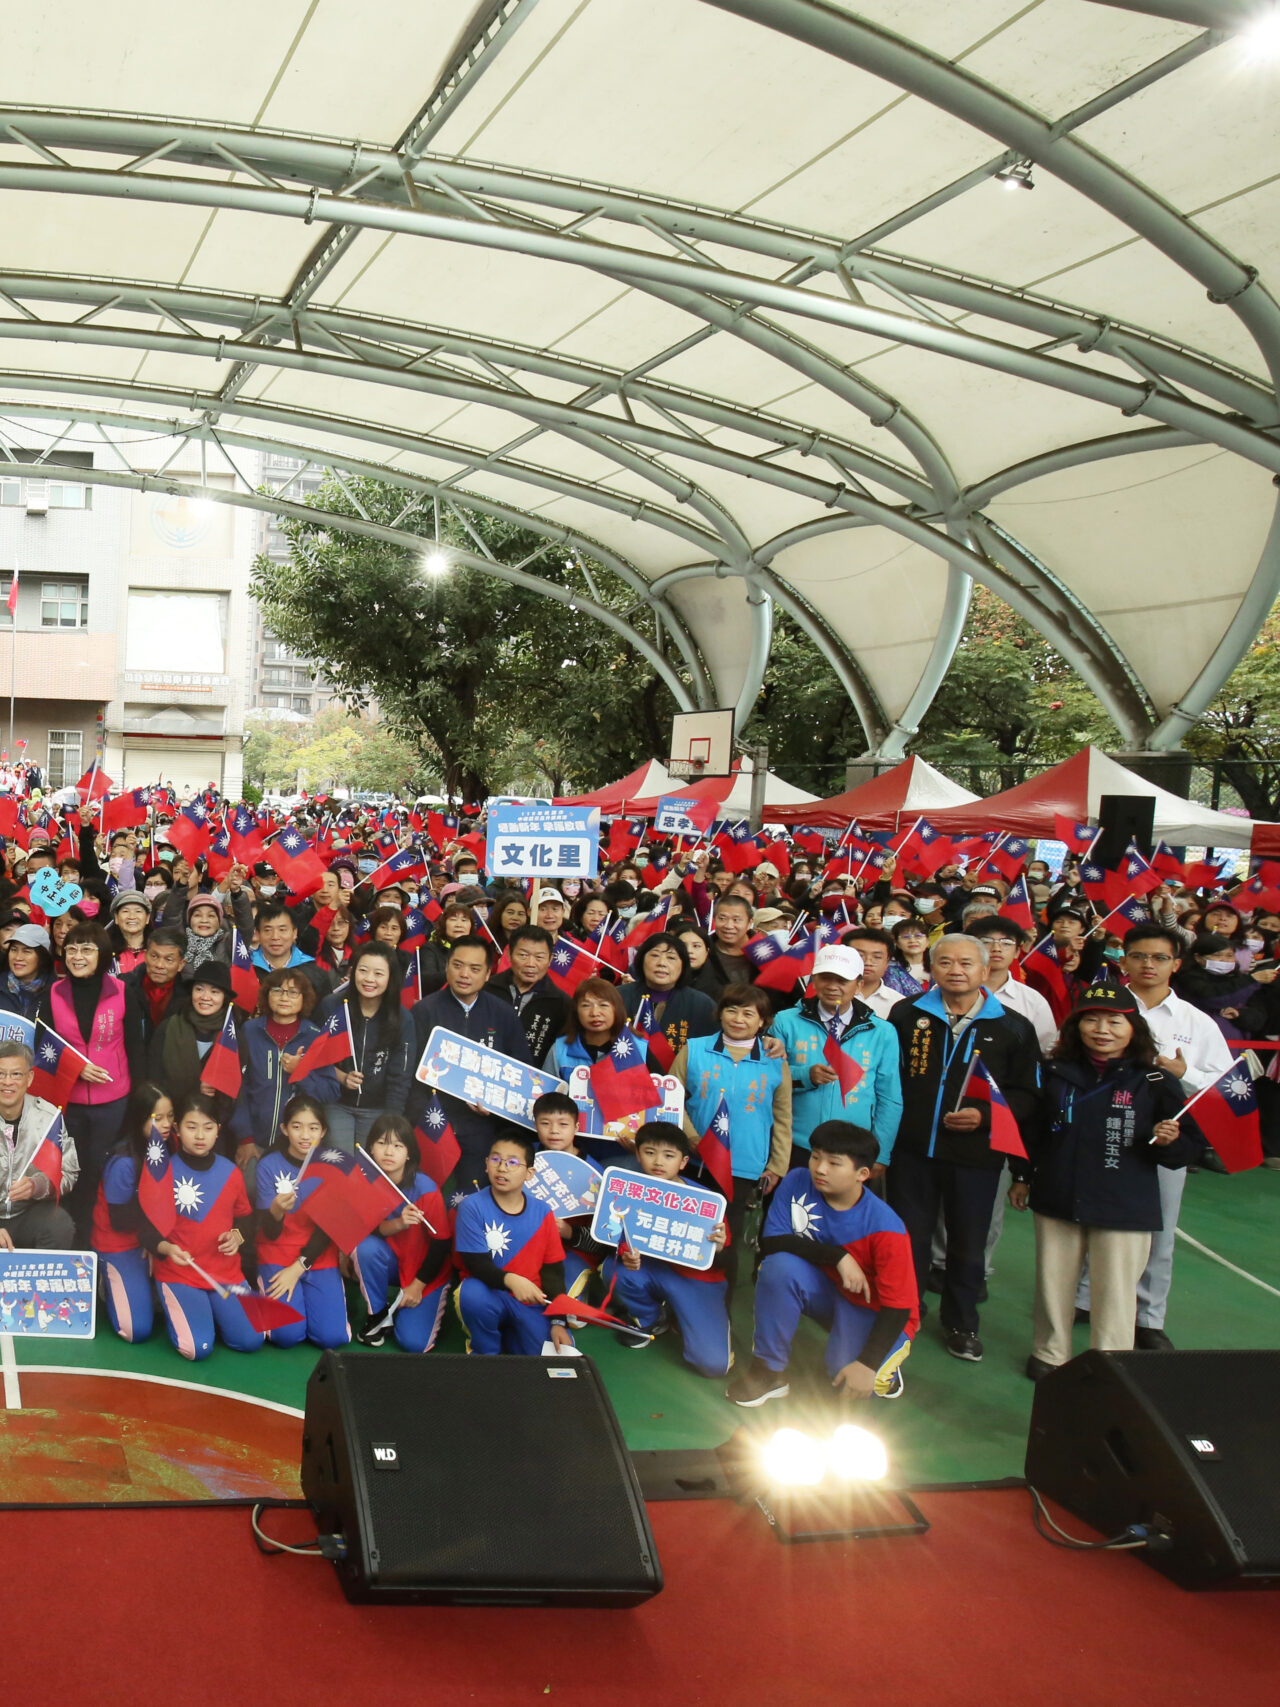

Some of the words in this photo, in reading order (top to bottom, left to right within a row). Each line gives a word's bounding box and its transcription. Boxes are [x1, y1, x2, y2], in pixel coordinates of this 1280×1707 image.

[501, 843, 581, 867] 文化里
[40, 884, 67, 908] 中正里
[43, 870, 81, 900] 中壢區
[439, 1039, 523, 1087] 運動新年
[608, 1177, 719, 1219] 齊聚文化公園
[632, 1234, 701, 1261] 一起升旗
